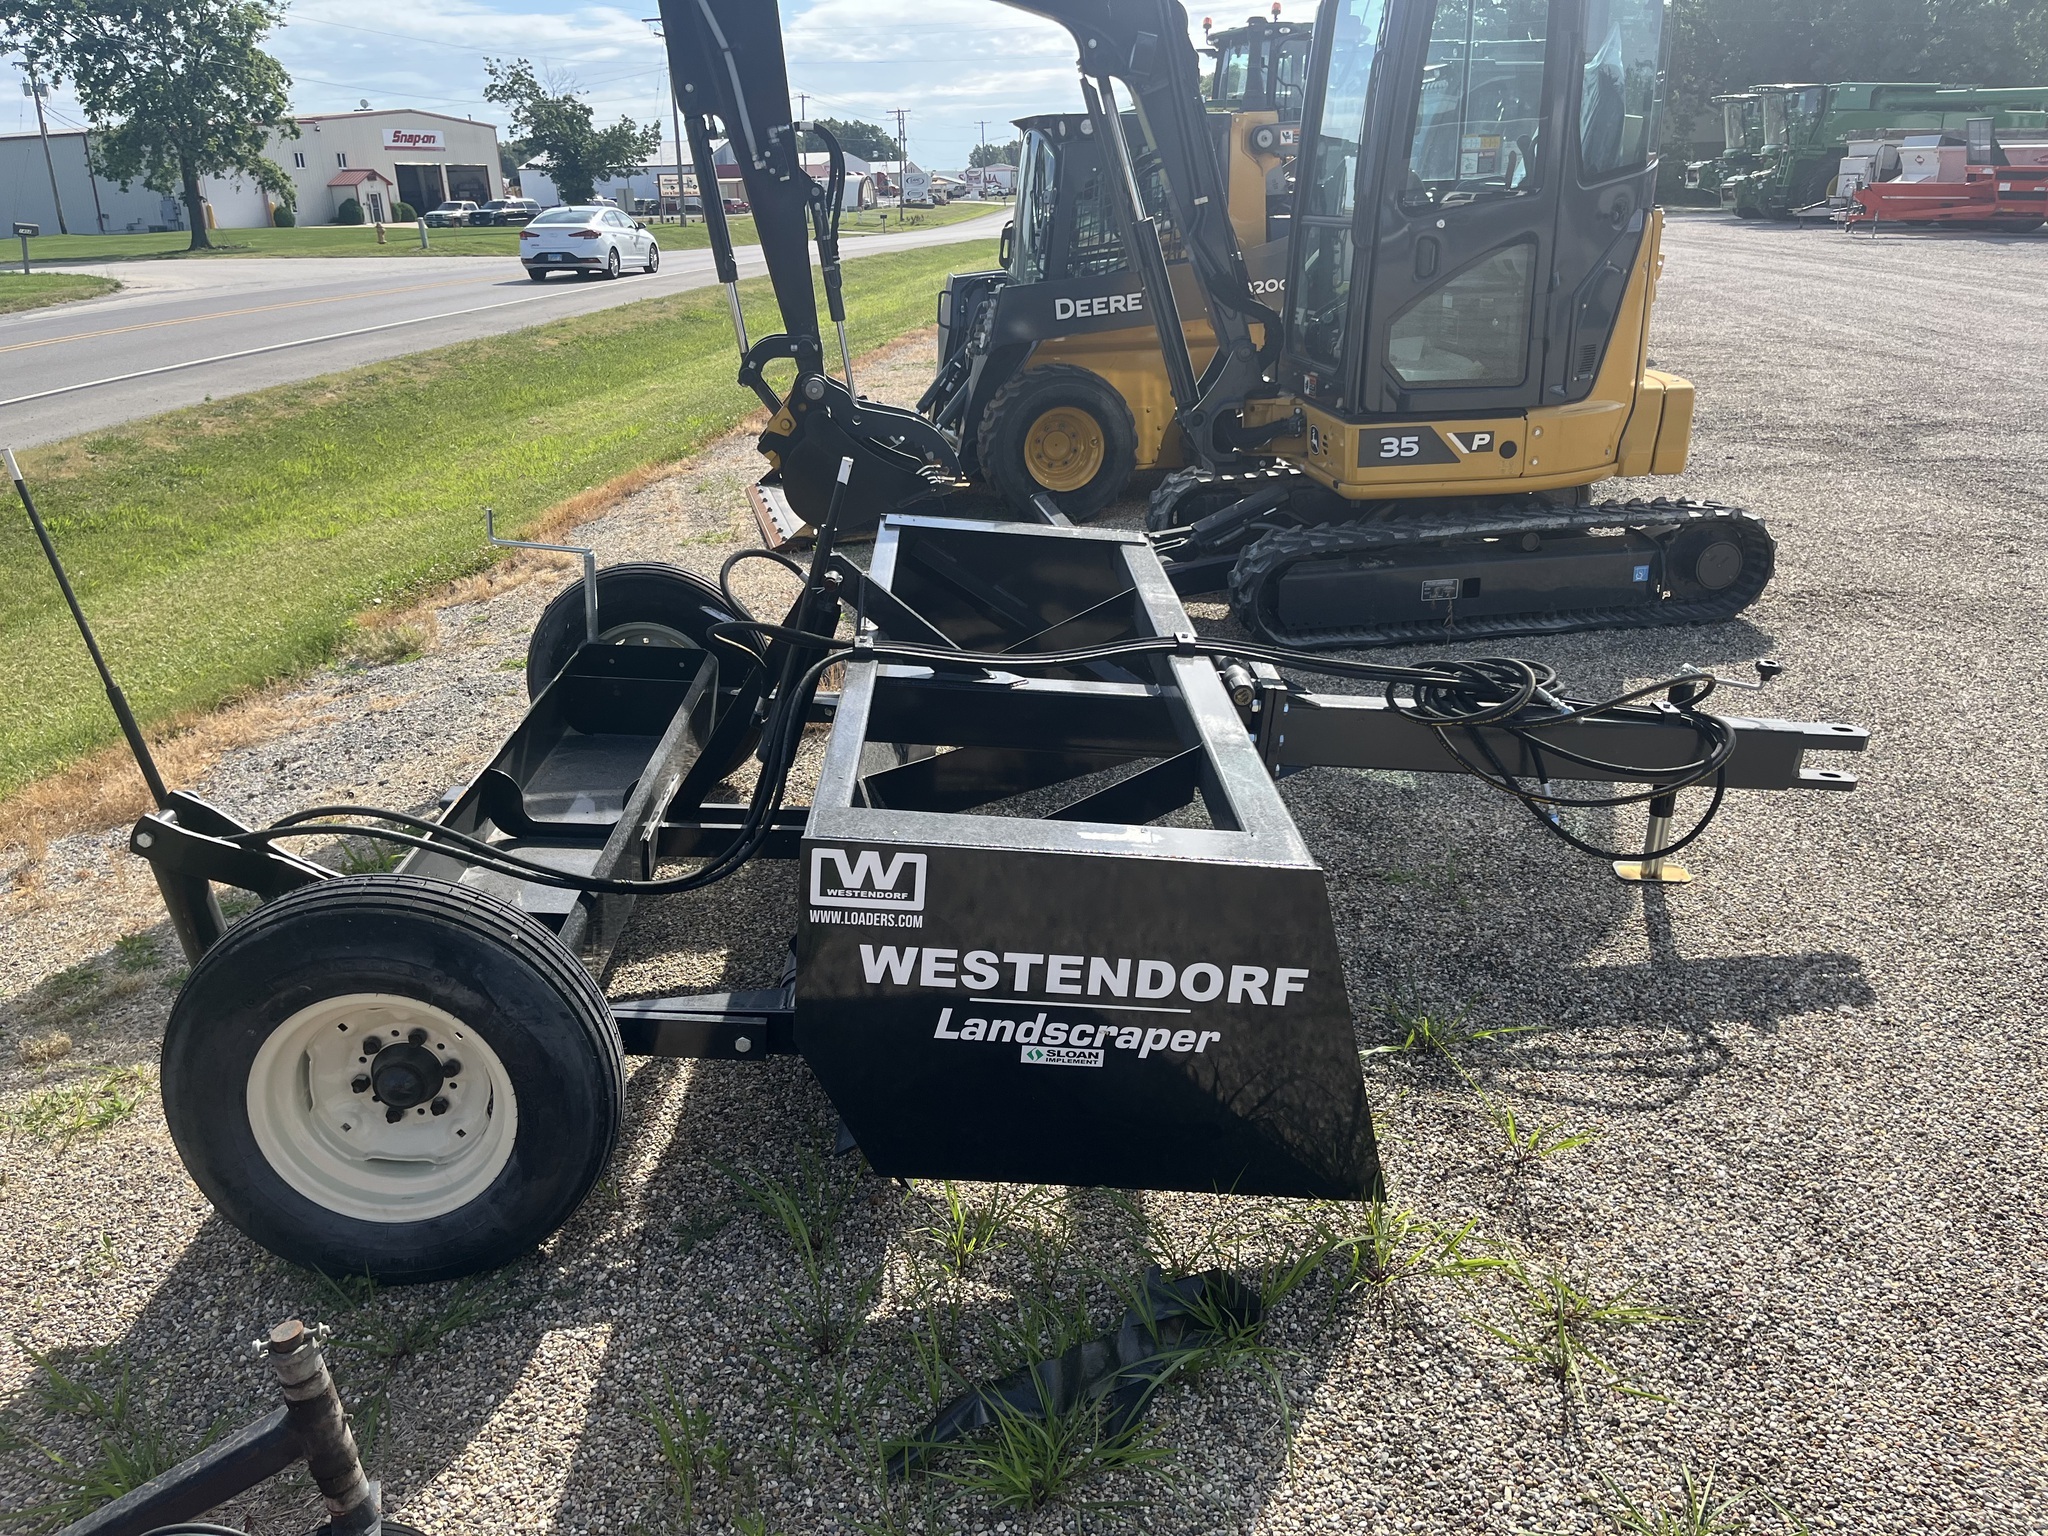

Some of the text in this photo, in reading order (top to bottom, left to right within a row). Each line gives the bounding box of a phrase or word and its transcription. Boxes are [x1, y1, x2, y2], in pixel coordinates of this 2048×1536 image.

[392, 130, 436, 146] Snap-on
[1055, 292, 1143, 320] DEERE
[1379, 433, 1491, 458] 35 P
[827, 888, 909, 900] WESTENDORF
[809, 909, 923, 928] WWW.LOADERS.COM
[859, 944, 1309, 1006] WESTENDORF
[933, 1007, 1221, 1058] Landscraper
[1045, 1057, 1098, 1065] IMPLEMENT
[1046, 1049, 1099, 1059] SLOAN
